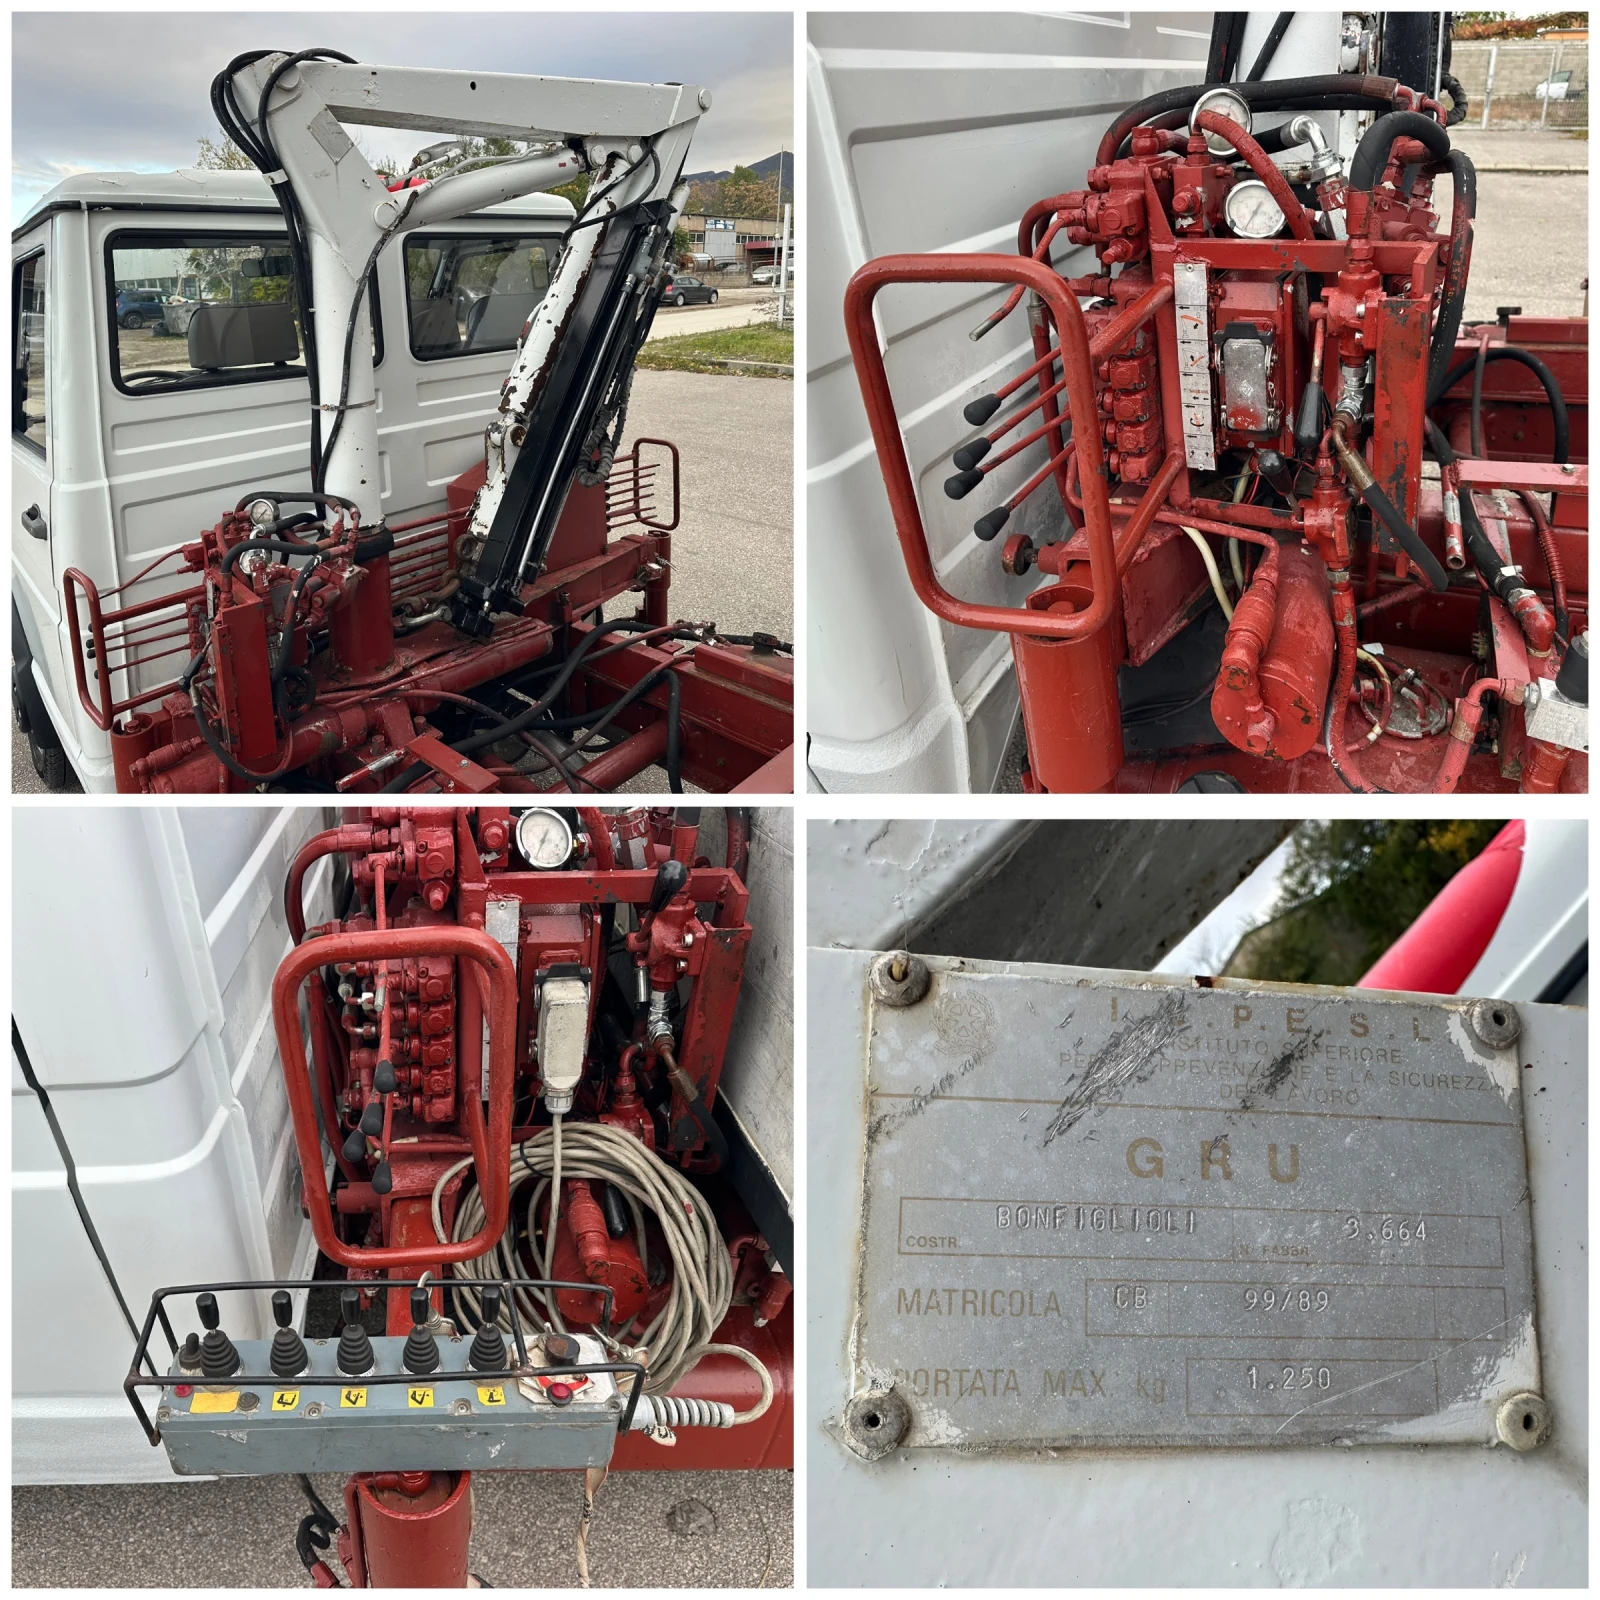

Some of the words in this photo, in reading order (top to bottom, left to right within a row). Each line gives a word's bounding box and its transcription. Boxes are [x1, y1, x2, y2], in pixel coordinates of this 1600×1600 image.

[1159, 1057, 1312, 1081] PREVENZINE
[1325, 1066, 1339, 1083] E
[1351, 1069, 1375, 1084] LA
[1274, 1085, 1361, 1106] LAVORO
[995, 1204, 1198, 1235] BONFIGLIOLI
[1344, 1215, 1428, 1243] 3.664
[896, 1287, 1063, 1318] MATRICOLA
[1113, 1284, 1148, 1310] CB
[1243, 1288, 1330, 1313] 99/89
[1137, 1370, 1167, 1405] kg
[1247, 1364, 1331, 1391] 1.250
